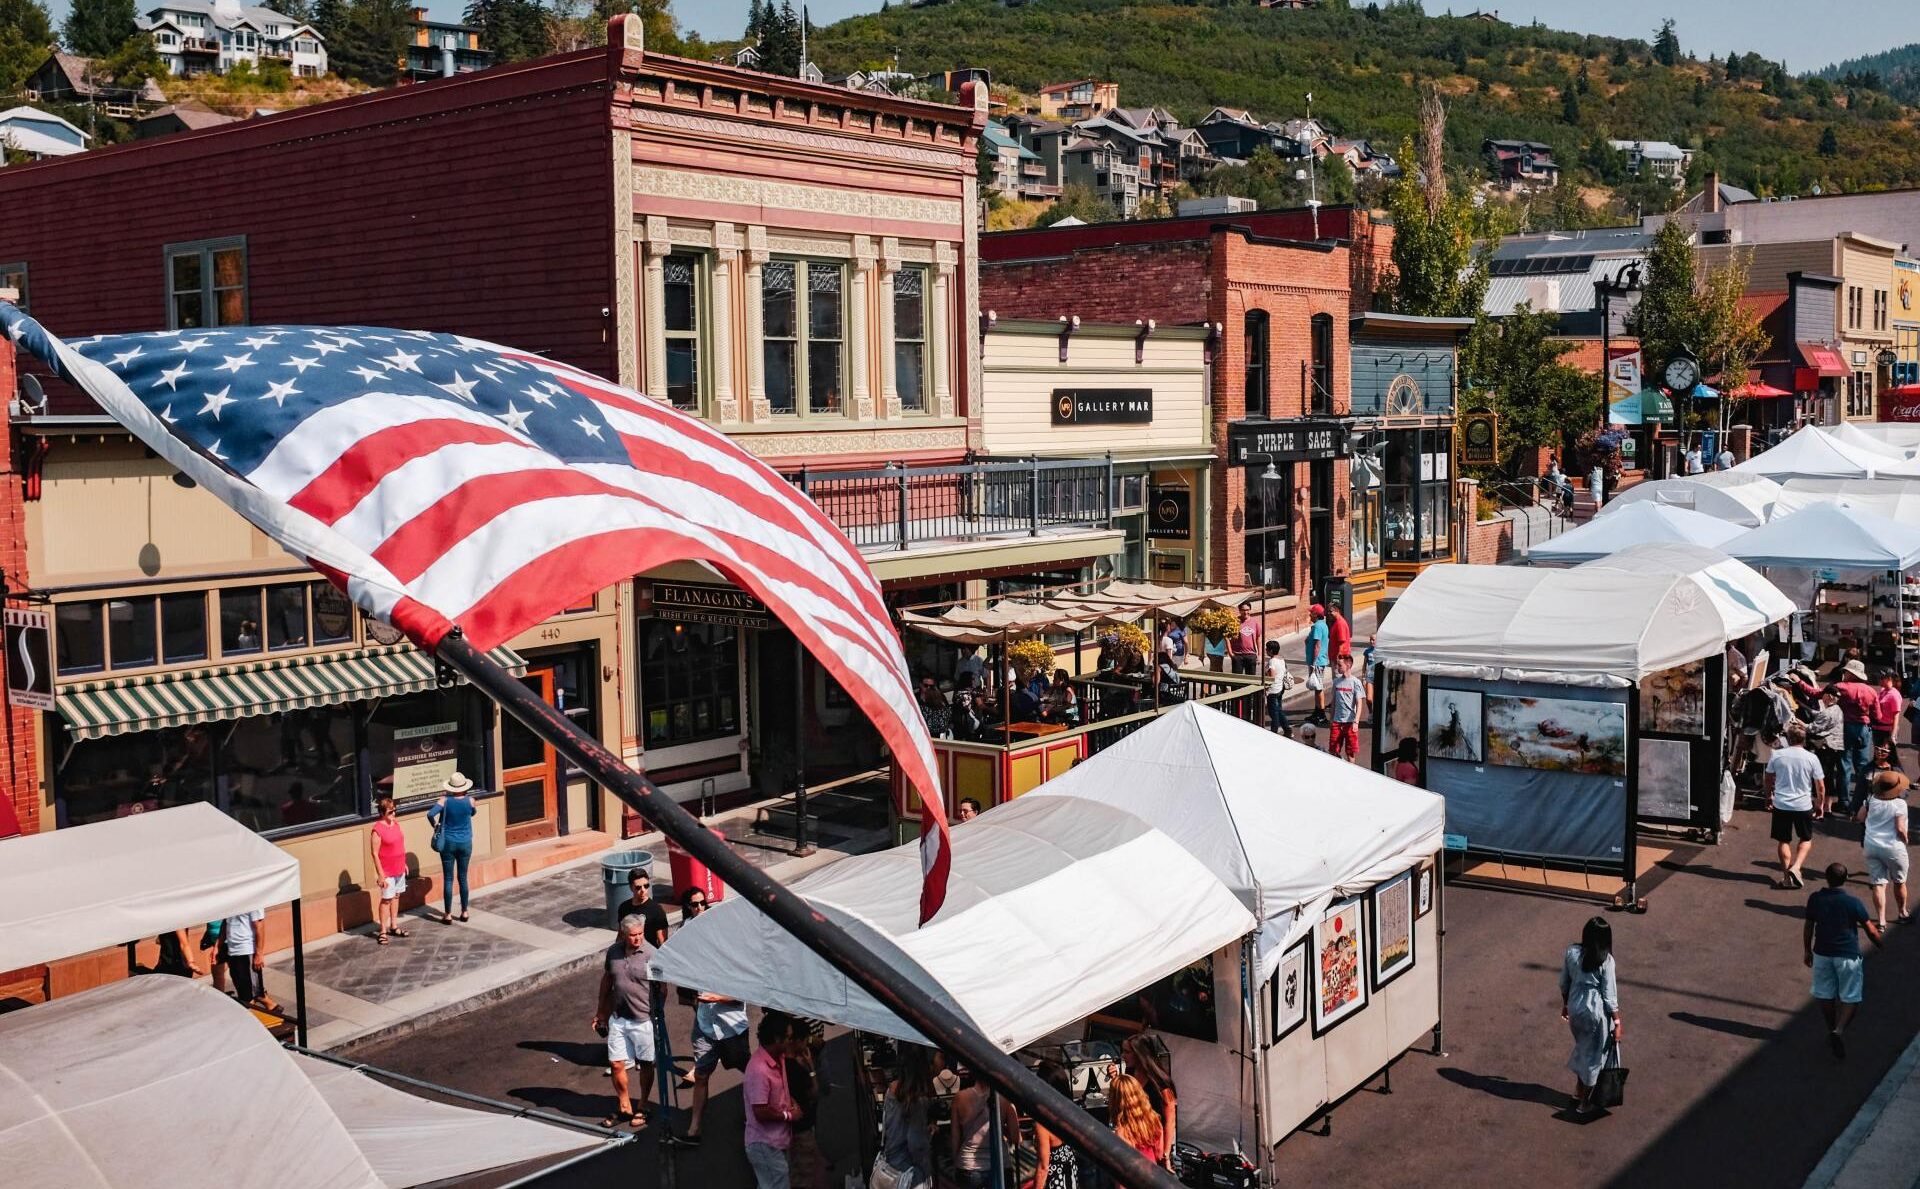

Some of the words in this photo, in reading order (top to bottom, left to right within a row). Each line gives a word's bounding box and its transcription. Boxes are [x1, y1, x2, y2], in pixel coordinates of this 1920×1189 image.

[1077, 402, 1125, 412] GALLERY
[1128, 401, 1149, 412] MAR
[1257, 432, 1294, 452] PURPLE
[1308, 430, 1331, 449] SAGE
[665, 588, 753, 608] FLANAGAN'S
[683, 612, 698, 621] PUB
[708, 615, 761, 627] RESTAURANT
[541, 628, 560, 640] 440
[397, 753, 427, 762] BERKSHIRE
[428, 749, 454, 758] HATHAWAY
